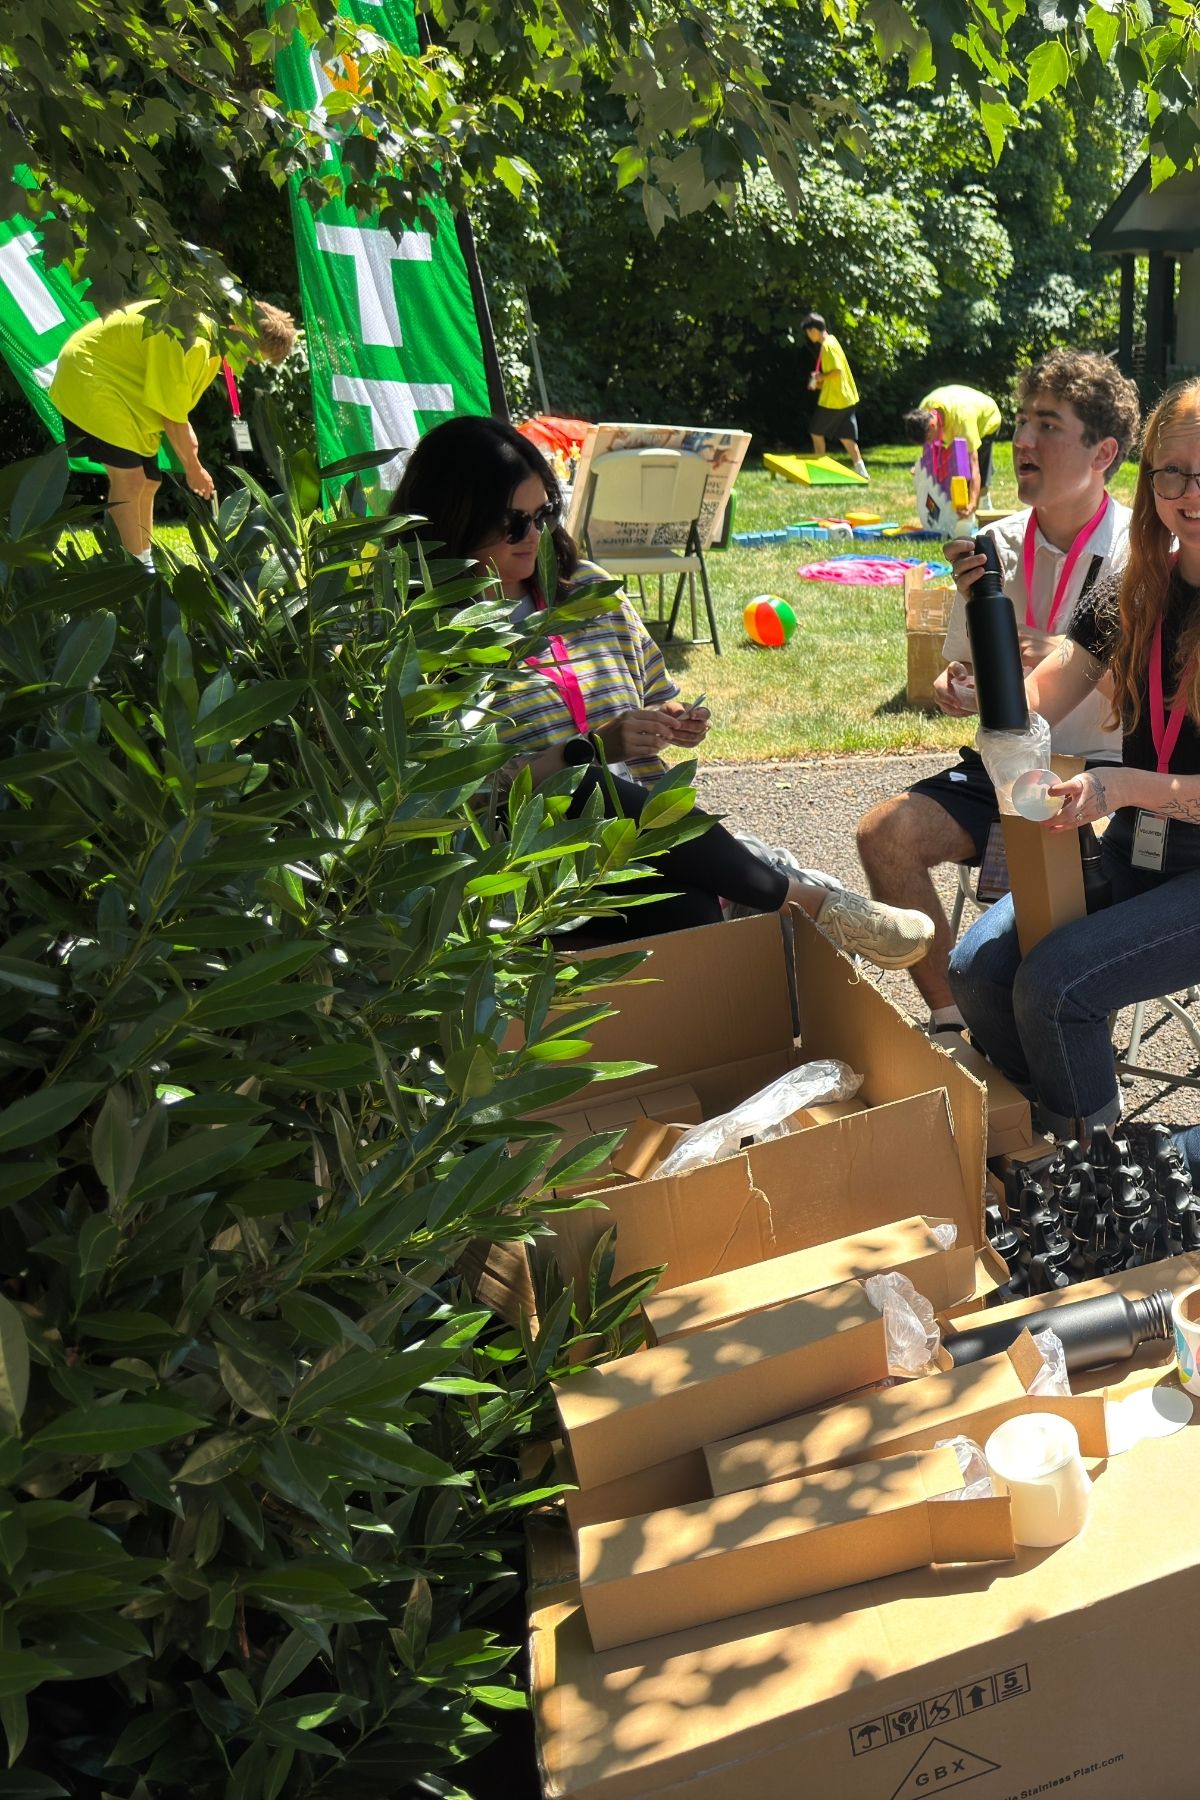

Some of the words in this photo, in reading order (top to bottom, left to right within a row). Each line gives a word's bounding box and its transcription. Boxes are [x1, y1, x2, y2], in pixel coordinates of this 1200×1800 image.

[916, 1759, 965, 1786] GBX
[1020, 1775, 1071, 1800] Stainless
[1073, 1752, 1125, 1779] Platt.com
